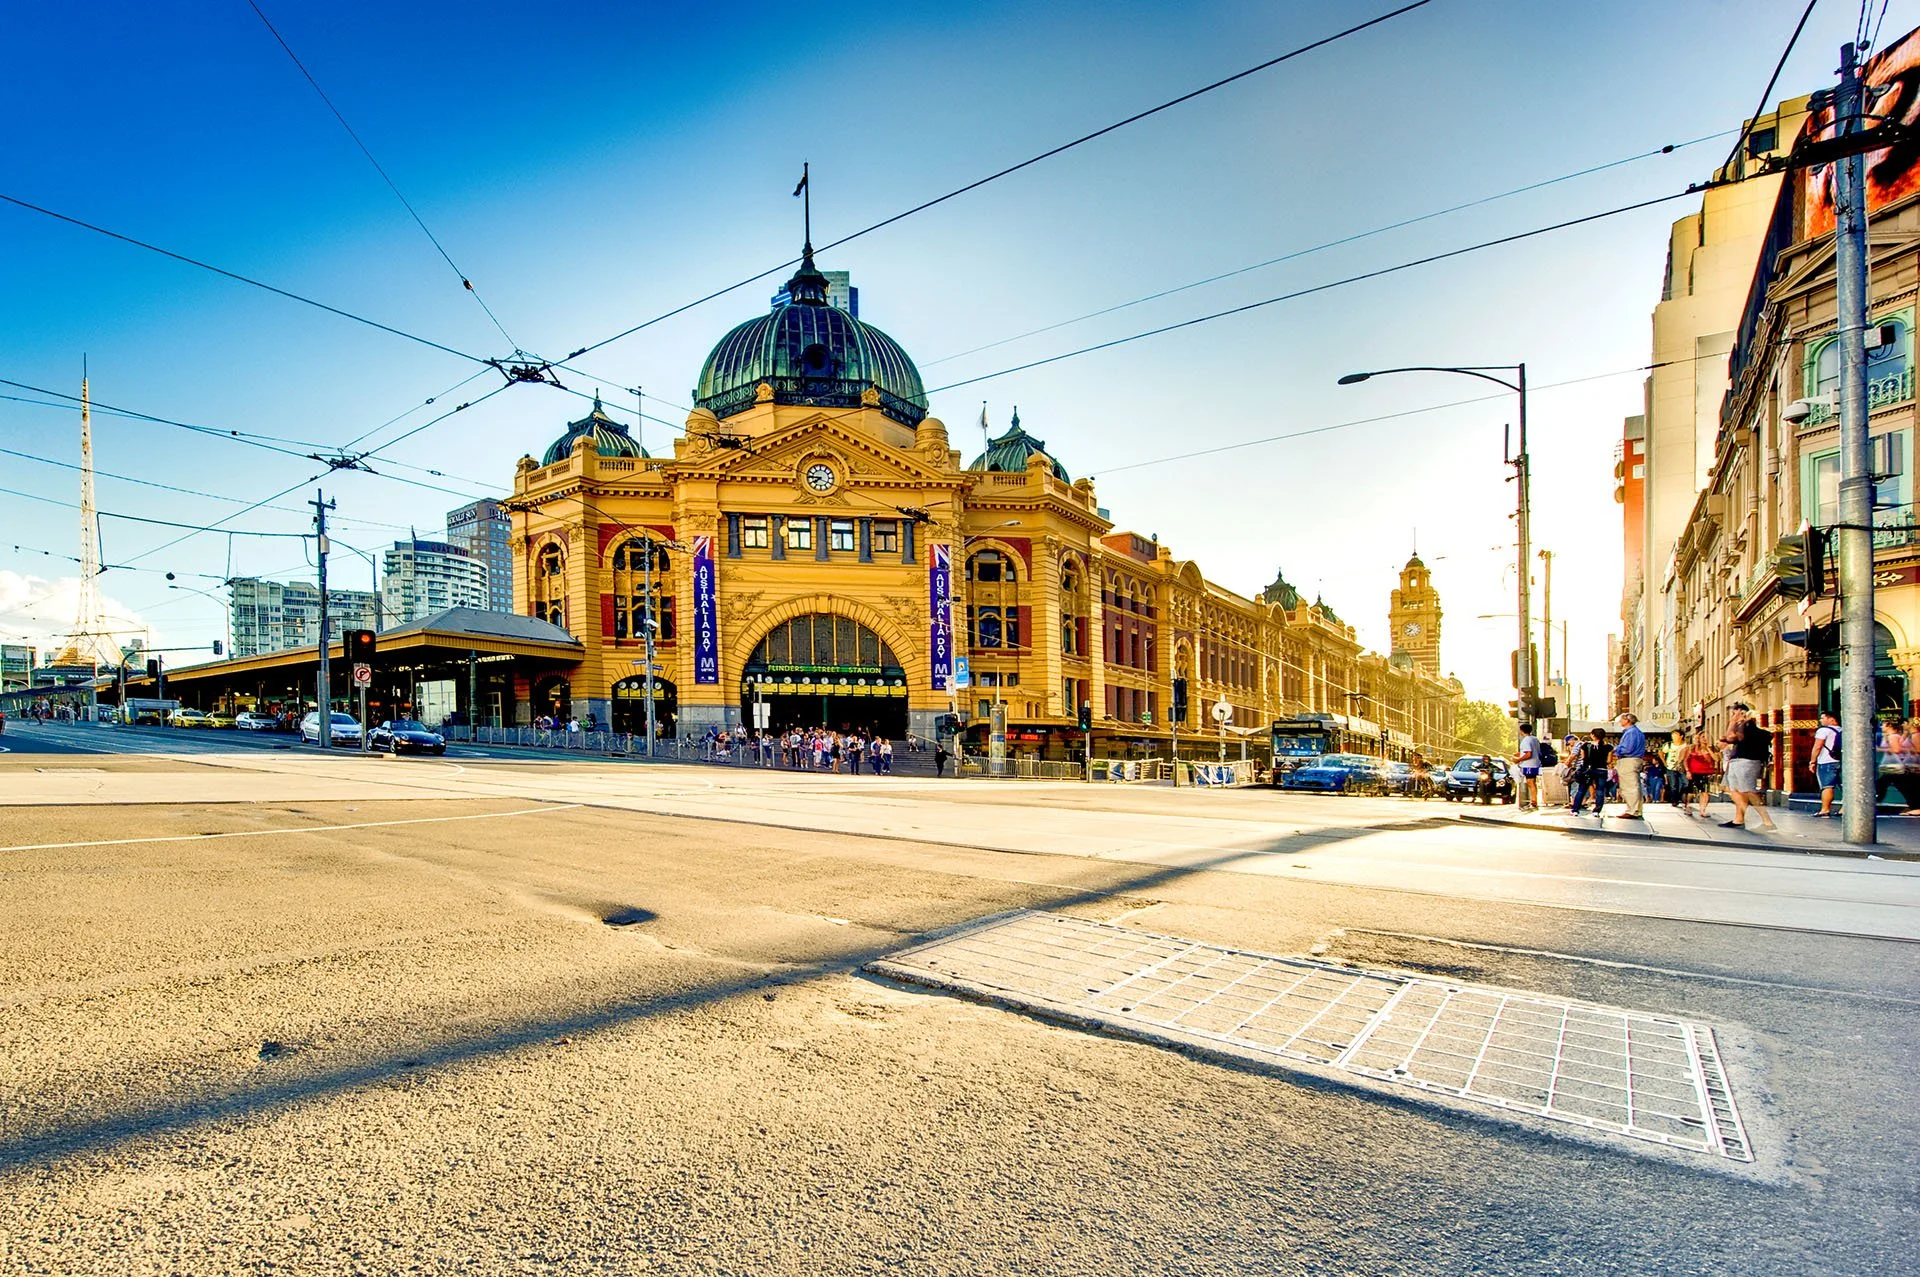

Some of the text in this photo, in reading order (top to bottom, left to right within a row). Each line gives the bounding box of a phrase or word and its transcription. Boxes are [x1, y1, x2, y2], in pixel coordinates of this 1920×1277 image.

[699, 565, 711, 652] AUSTRALIA DAY
[936, 573, 946, 636] AUSRALIA
[937, 638, 946, 659] DAY
[767, 665, 881, 675] FLINDERS STREET STATION
